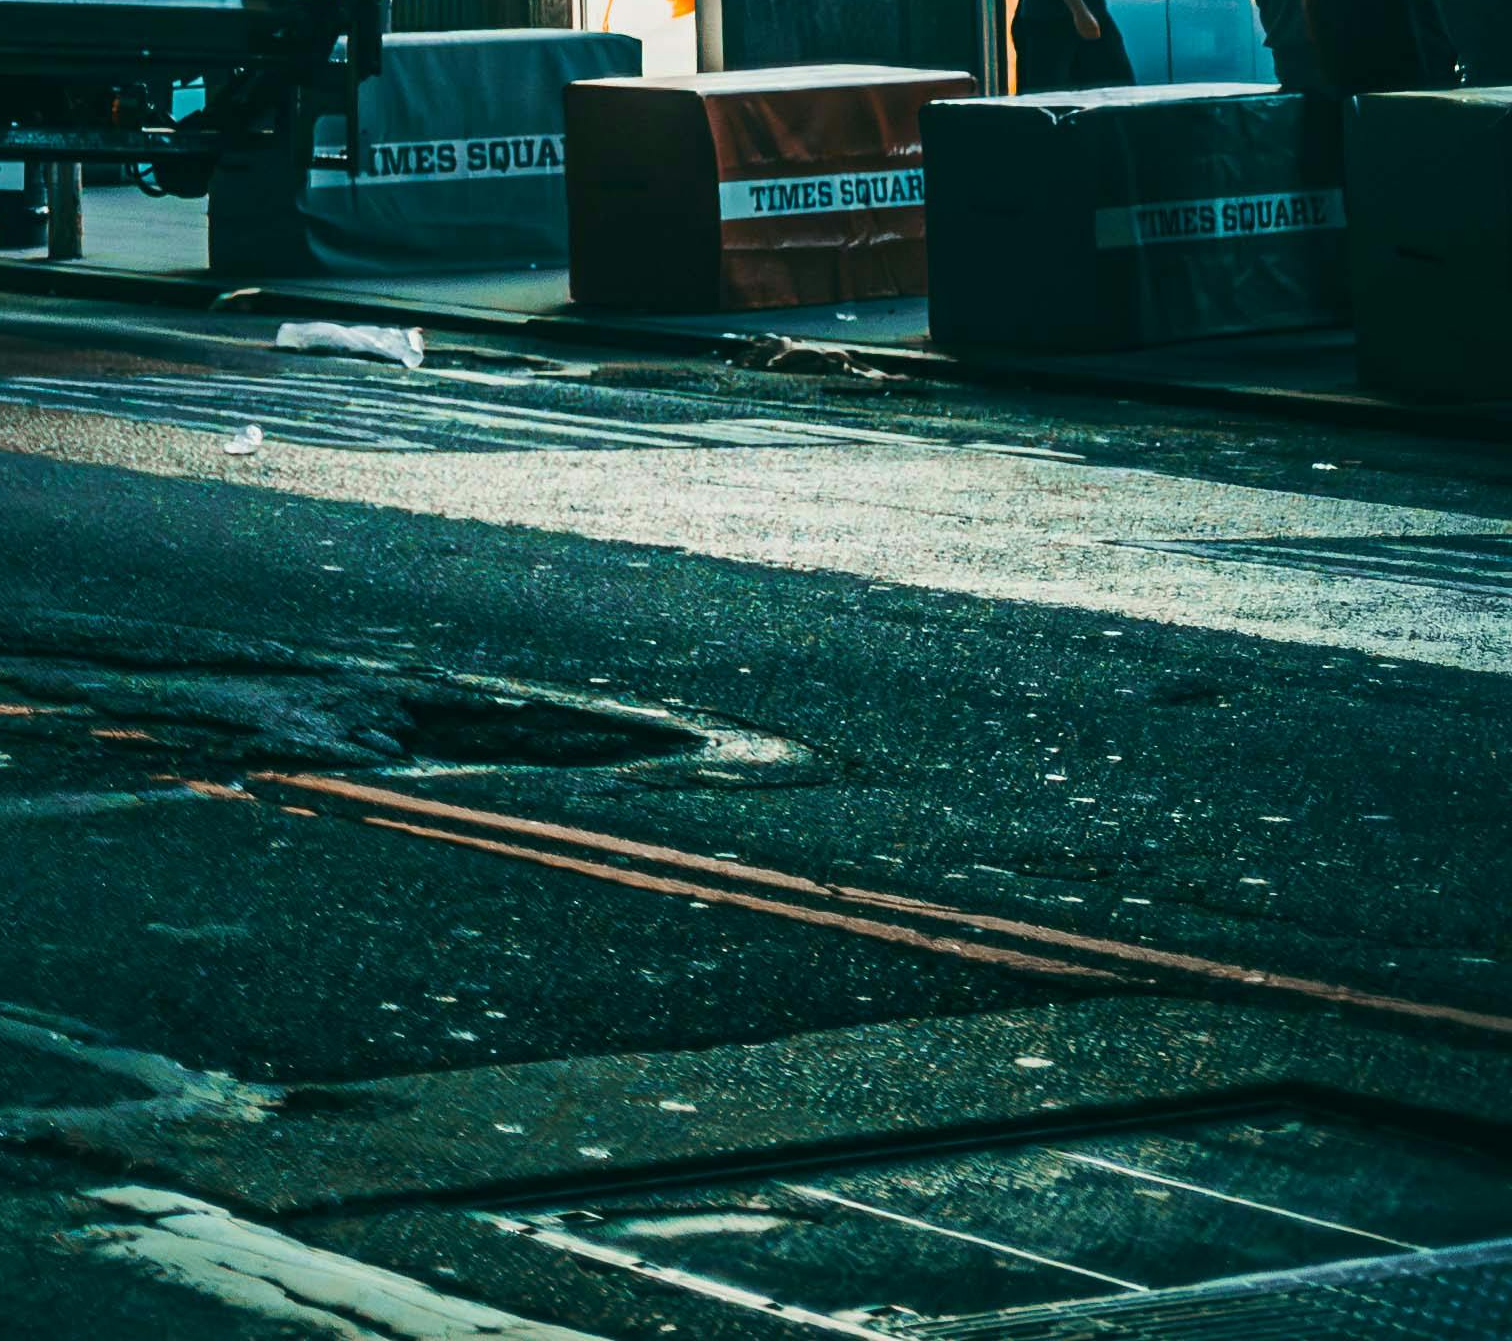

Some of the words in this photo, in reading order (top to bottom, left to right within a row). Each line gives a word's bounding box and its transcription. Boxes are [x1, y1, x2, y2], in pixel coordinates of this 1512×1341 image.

[367, 143, 457, 177] IMES
[467, 137, 565, 174] SQUA
[750, 181, 833, 213] TIMES
[840, 173, 924, 206] SQUAR
[1136, 203, 1216, 239] TIMES
[1222, 193, 1331, 233] SQUARE
